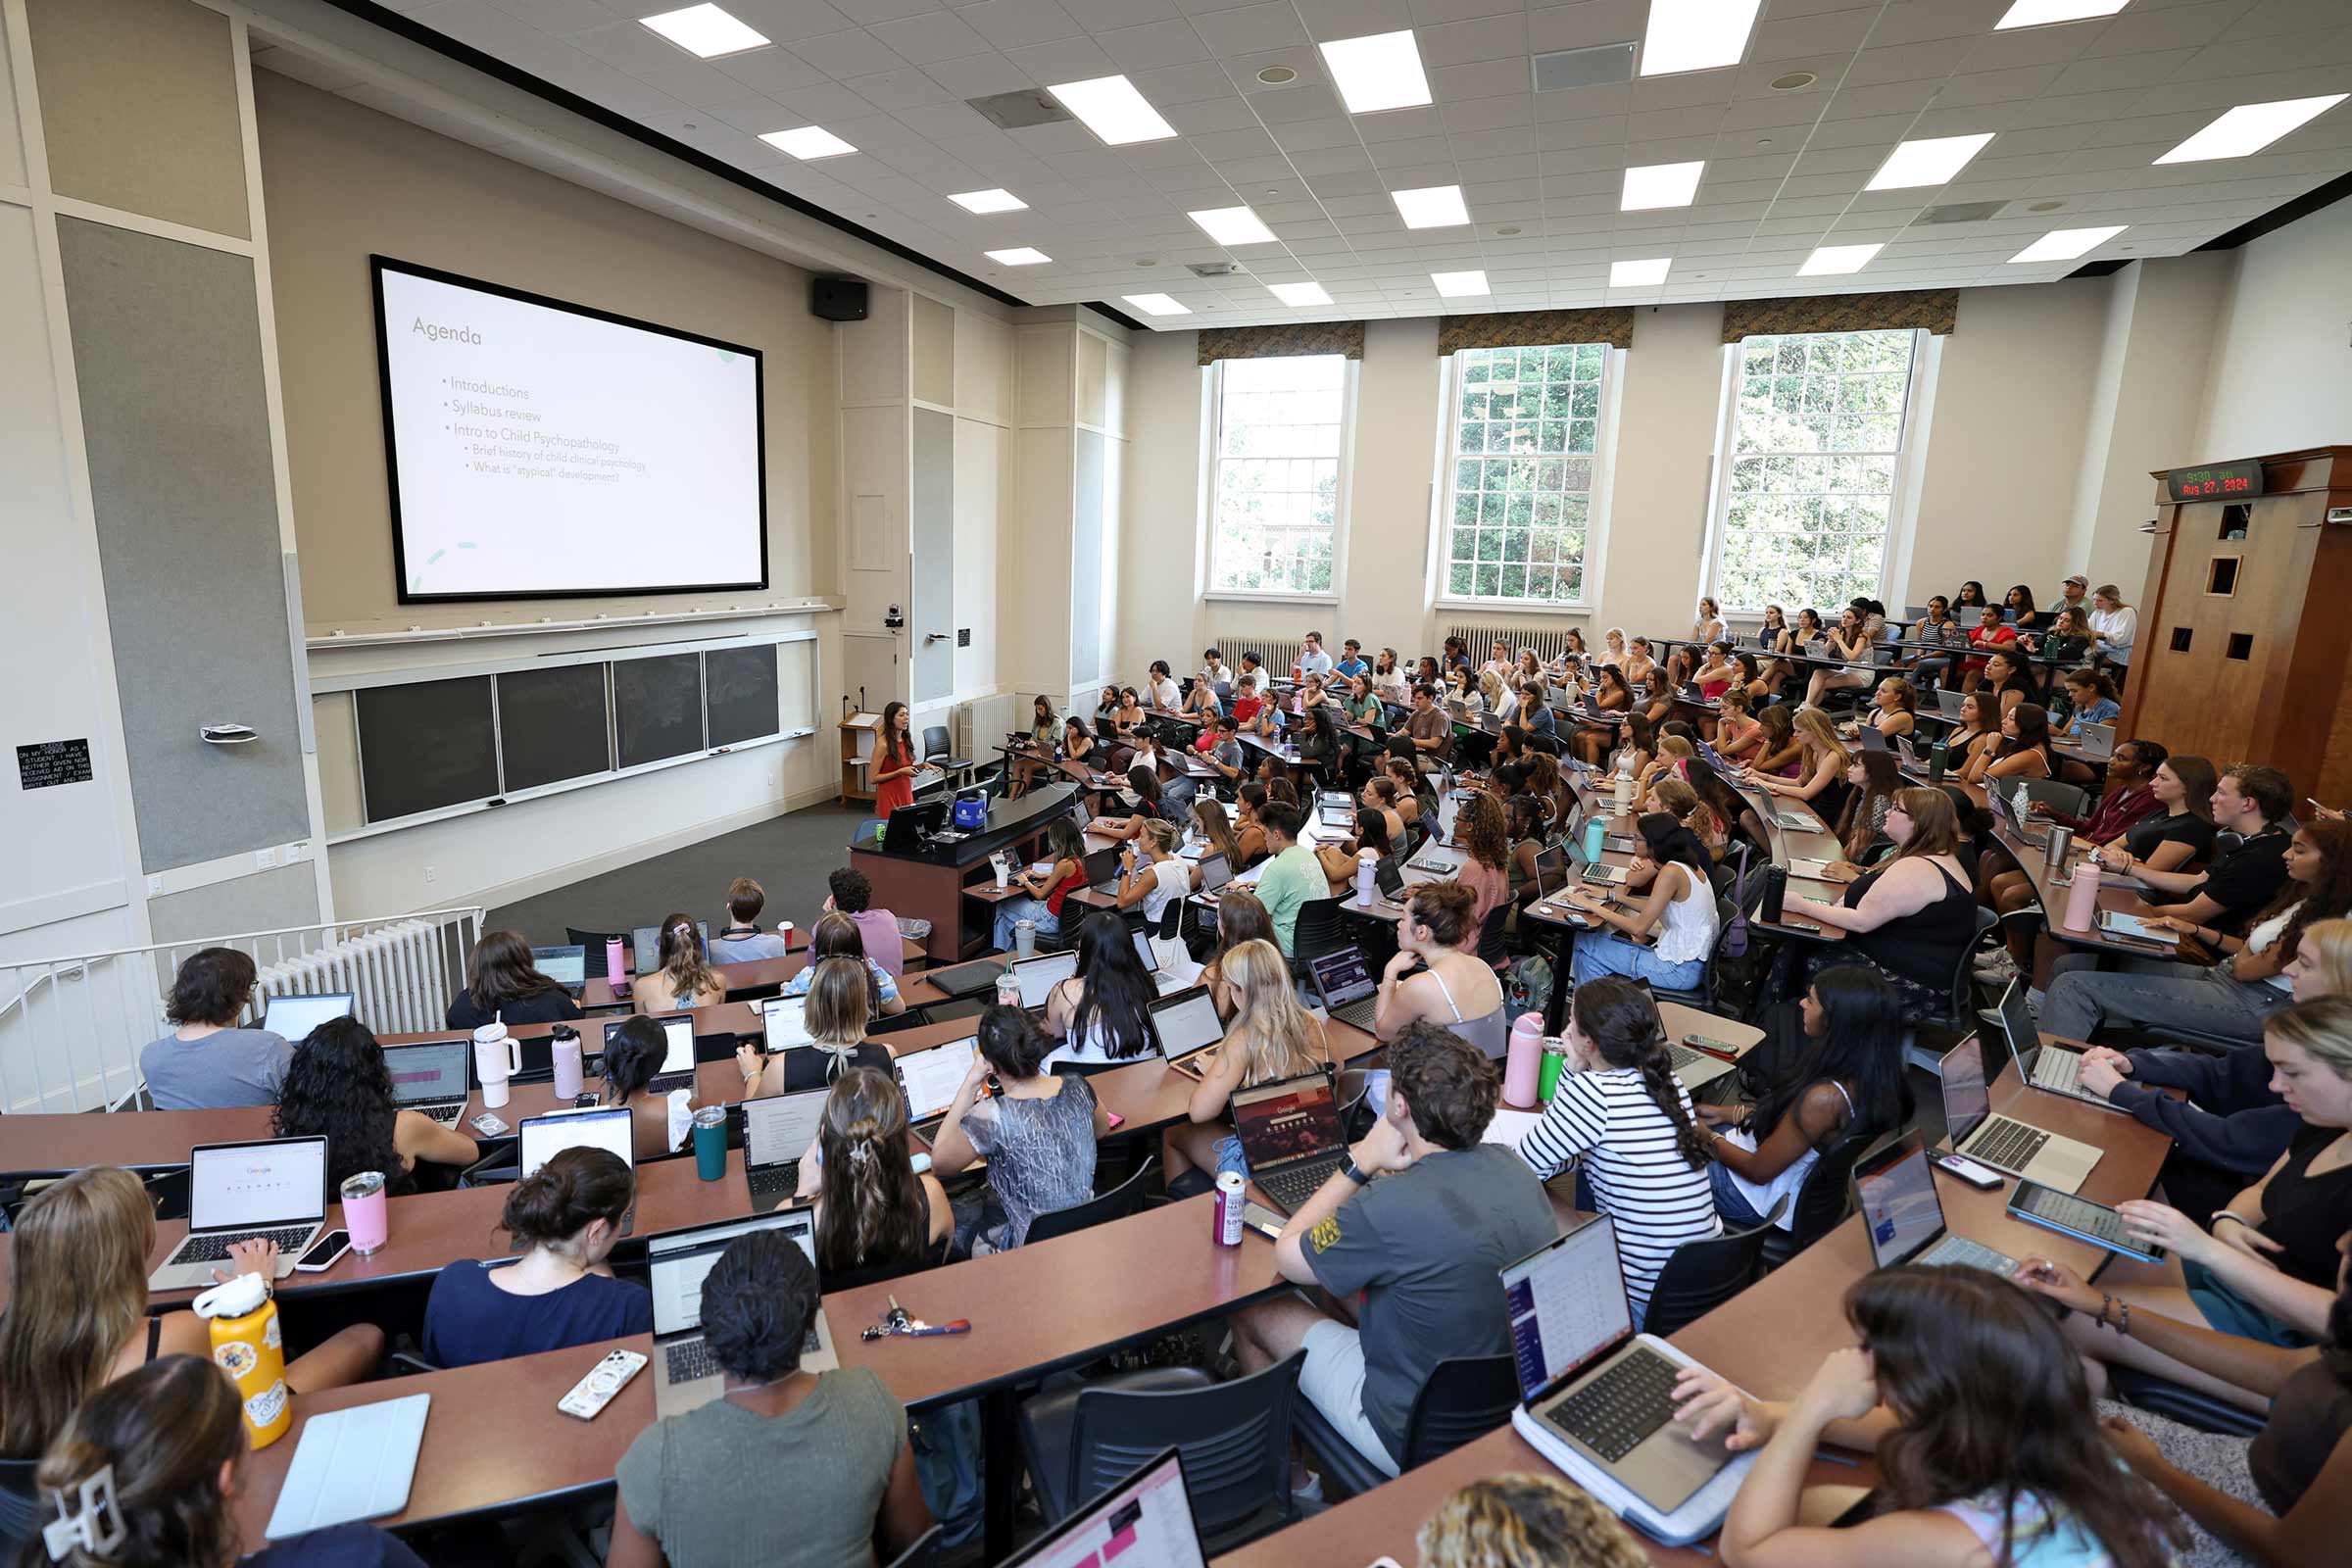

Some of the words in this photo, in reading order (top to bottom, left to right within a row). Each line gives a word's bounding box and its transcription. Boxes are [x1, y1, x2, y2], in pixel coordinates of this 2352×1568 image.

[413, 316, 481, 345] Agenda
[451, 376, 529, 400] Introductions
[453, 399, 502, 417] Syllabus
[505, 409, 541, 421] review
[454, 423, 483, 438] Intro
[486, 428, 498, 439] to
[501, 427, 531, 443] Child
[533, 431, 620, 455] Psychopathology
[472, 444, 497, 457] Brief
[499, 445, 531, 461] history
[534, 450, 544, 461] of
[546, 450, 567, 463] child
[569, 453, 599, 466] clinical
[600, 457, 647, 471] psychology
[473, 462, 501, 474] What
[503, 465, 511, 474] is
[558, 468, 620, 482] development?
[2187, 471, 2210, 483] 9:30
[2225, 478, 2248, 492] 2024
[1277, 1104, 1296, 1114] Google
